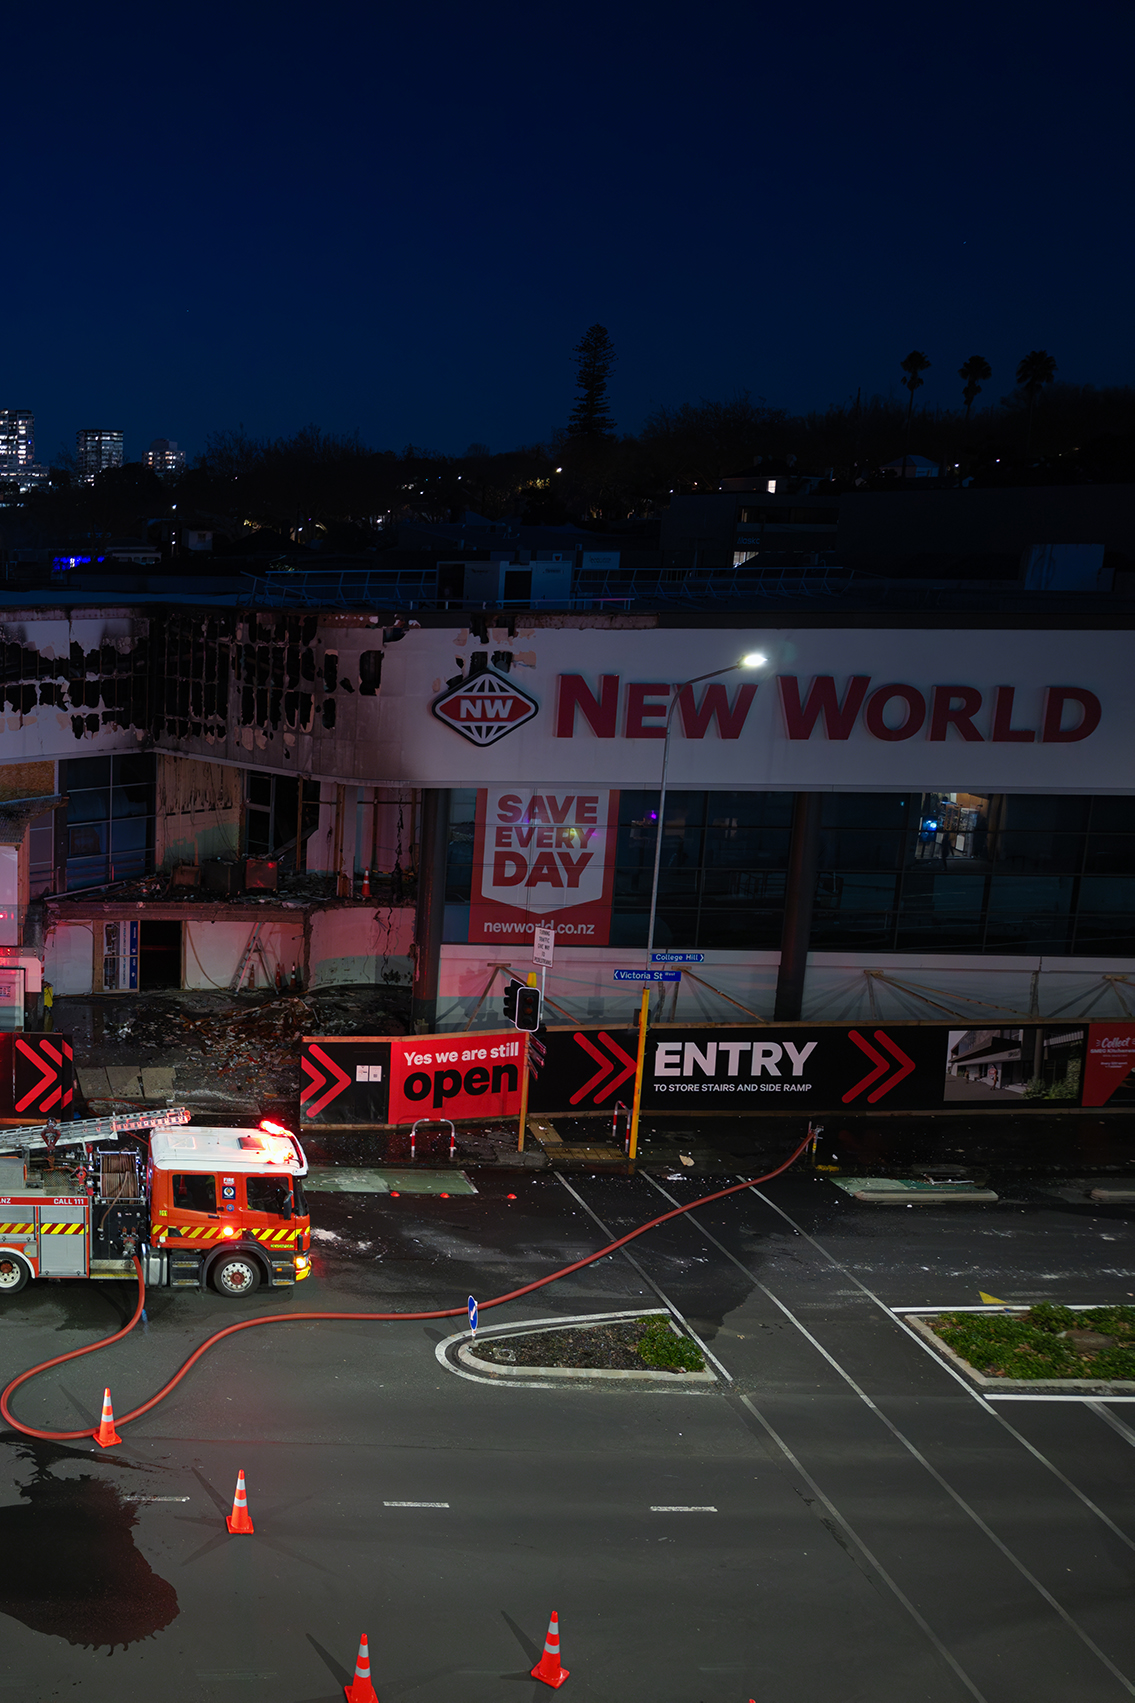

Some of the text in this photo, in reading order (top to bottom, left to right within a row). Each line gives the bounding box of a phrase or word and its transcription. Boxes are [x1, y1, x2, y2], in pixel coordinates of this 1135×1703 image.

[458, 697, 513, 719] NW
[554, 673, 1103, 743] NEW WORLD
[496, 793, 599, 824] SAVE
[495, 826, 597, 849] EVERY
[492, 851, 595, 888] DAY
[655, 953, 683, 962] College
[619, 971, 651, 980] Victoria
[653, 972, 663, 980] St
[404, 1041, 519, 1066] Yes we are still
[1101, 1036, 1131, 1048] Collect
[654, 1042, 818, 1077] ENTRY
[404, 1063, 518, 1109] open
[654, 1083, 812, 1092] TO STORE STAIRS AND SIDE RAMP
